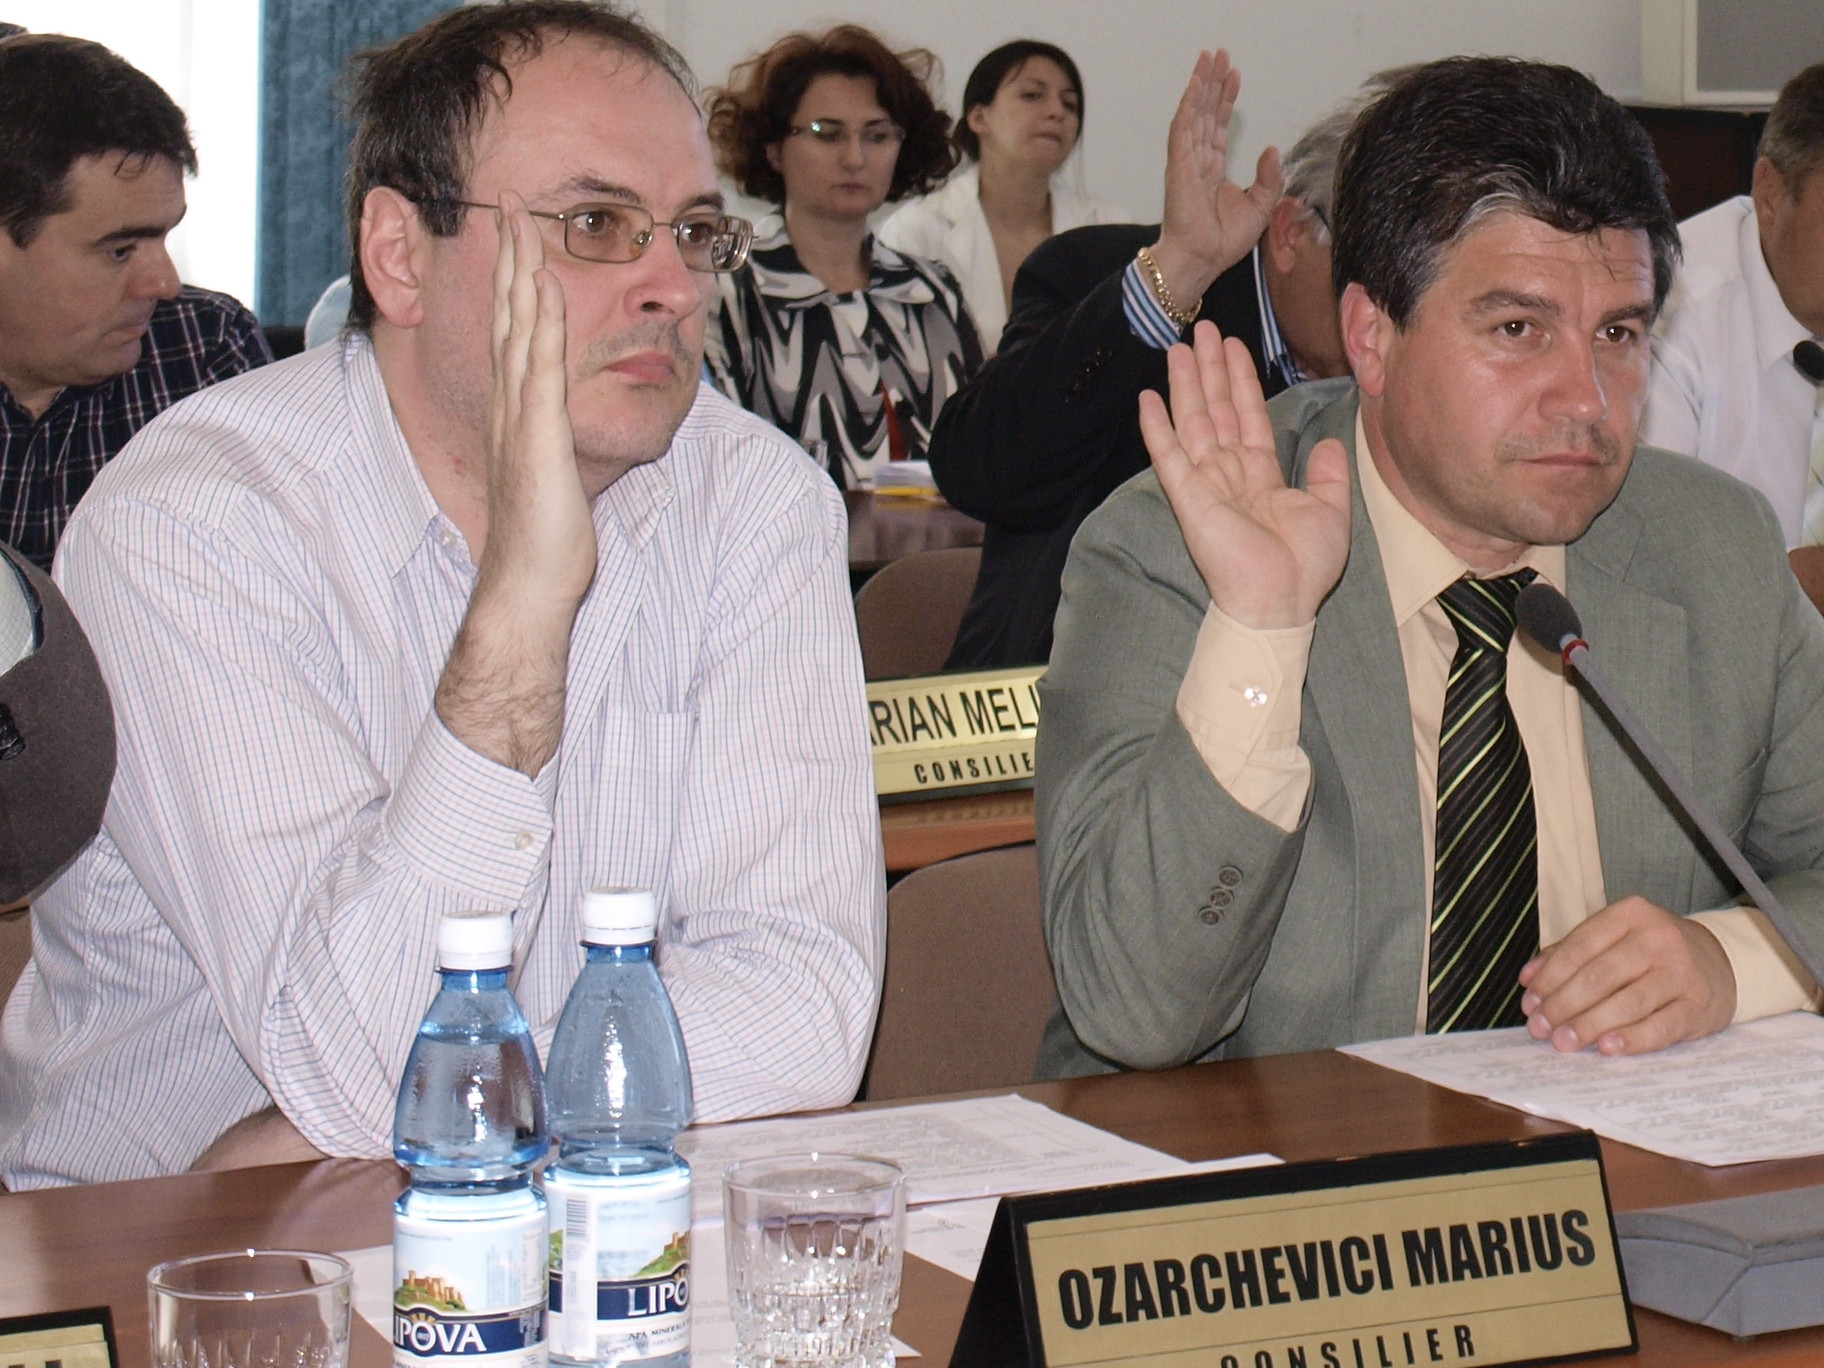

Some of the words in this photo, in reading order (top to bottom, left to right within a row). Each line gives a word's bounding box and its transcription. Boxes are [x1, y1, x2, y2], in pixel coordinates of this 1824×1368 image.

[868, 693, 957, 746] RIAN
[1057, 1233, 1395, 1330] OZARCHEVICI
[1404, 1209, 1596, 1287] MARIUS
